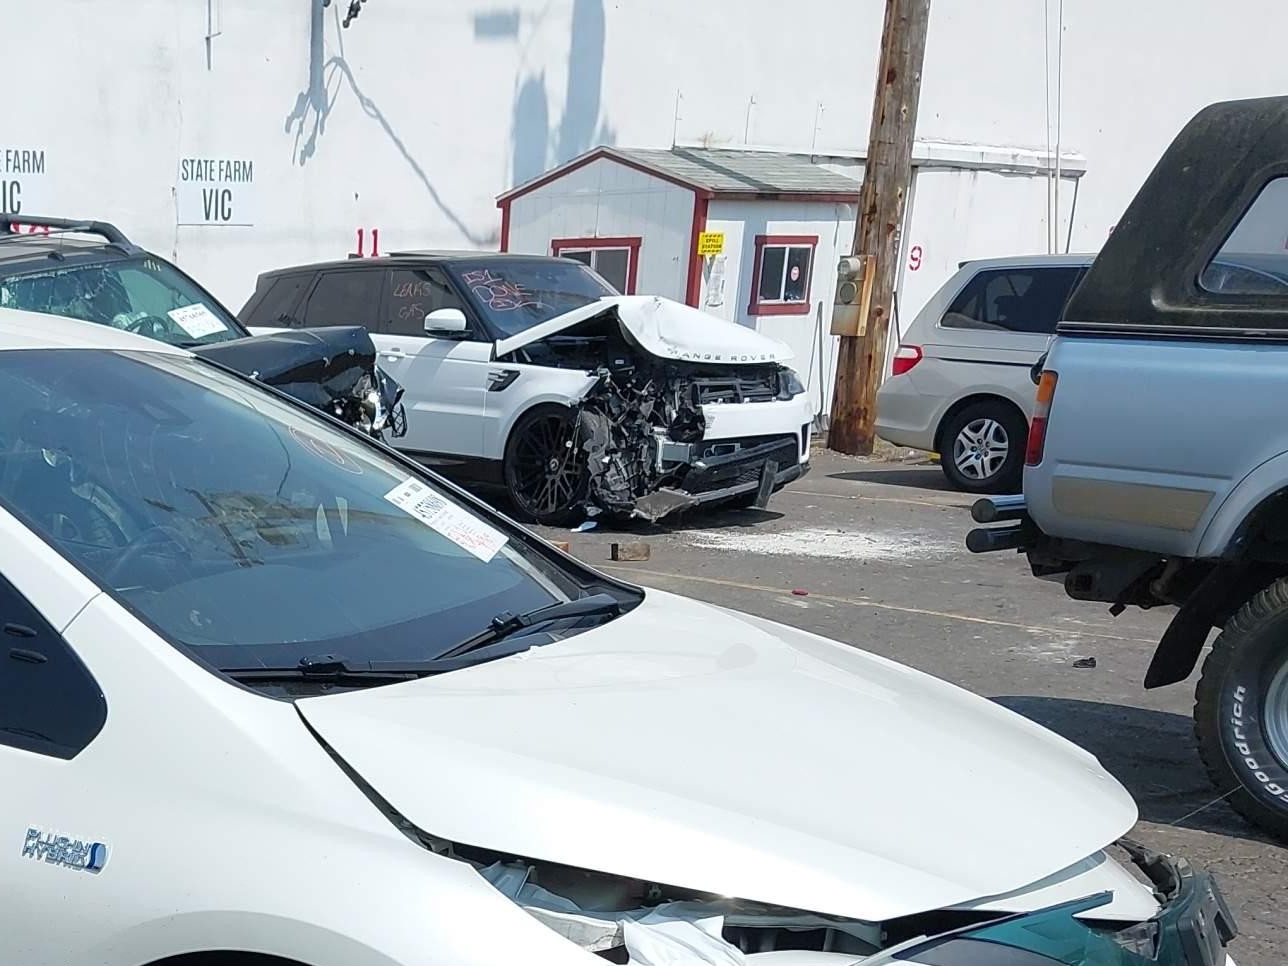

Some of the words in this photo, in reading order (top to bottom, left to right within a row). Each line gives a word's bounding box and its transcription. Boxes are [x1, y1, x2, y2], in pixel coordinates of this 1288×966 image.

[6, 150, 45, 175] FARM
[182, 158, 216, 183] STATE
[219, 160, 253, 183] FARM
[203, 189, 233, 222] VIC
[357, 228, 379, 257] 11
[909, 246, 923, 271] 9
